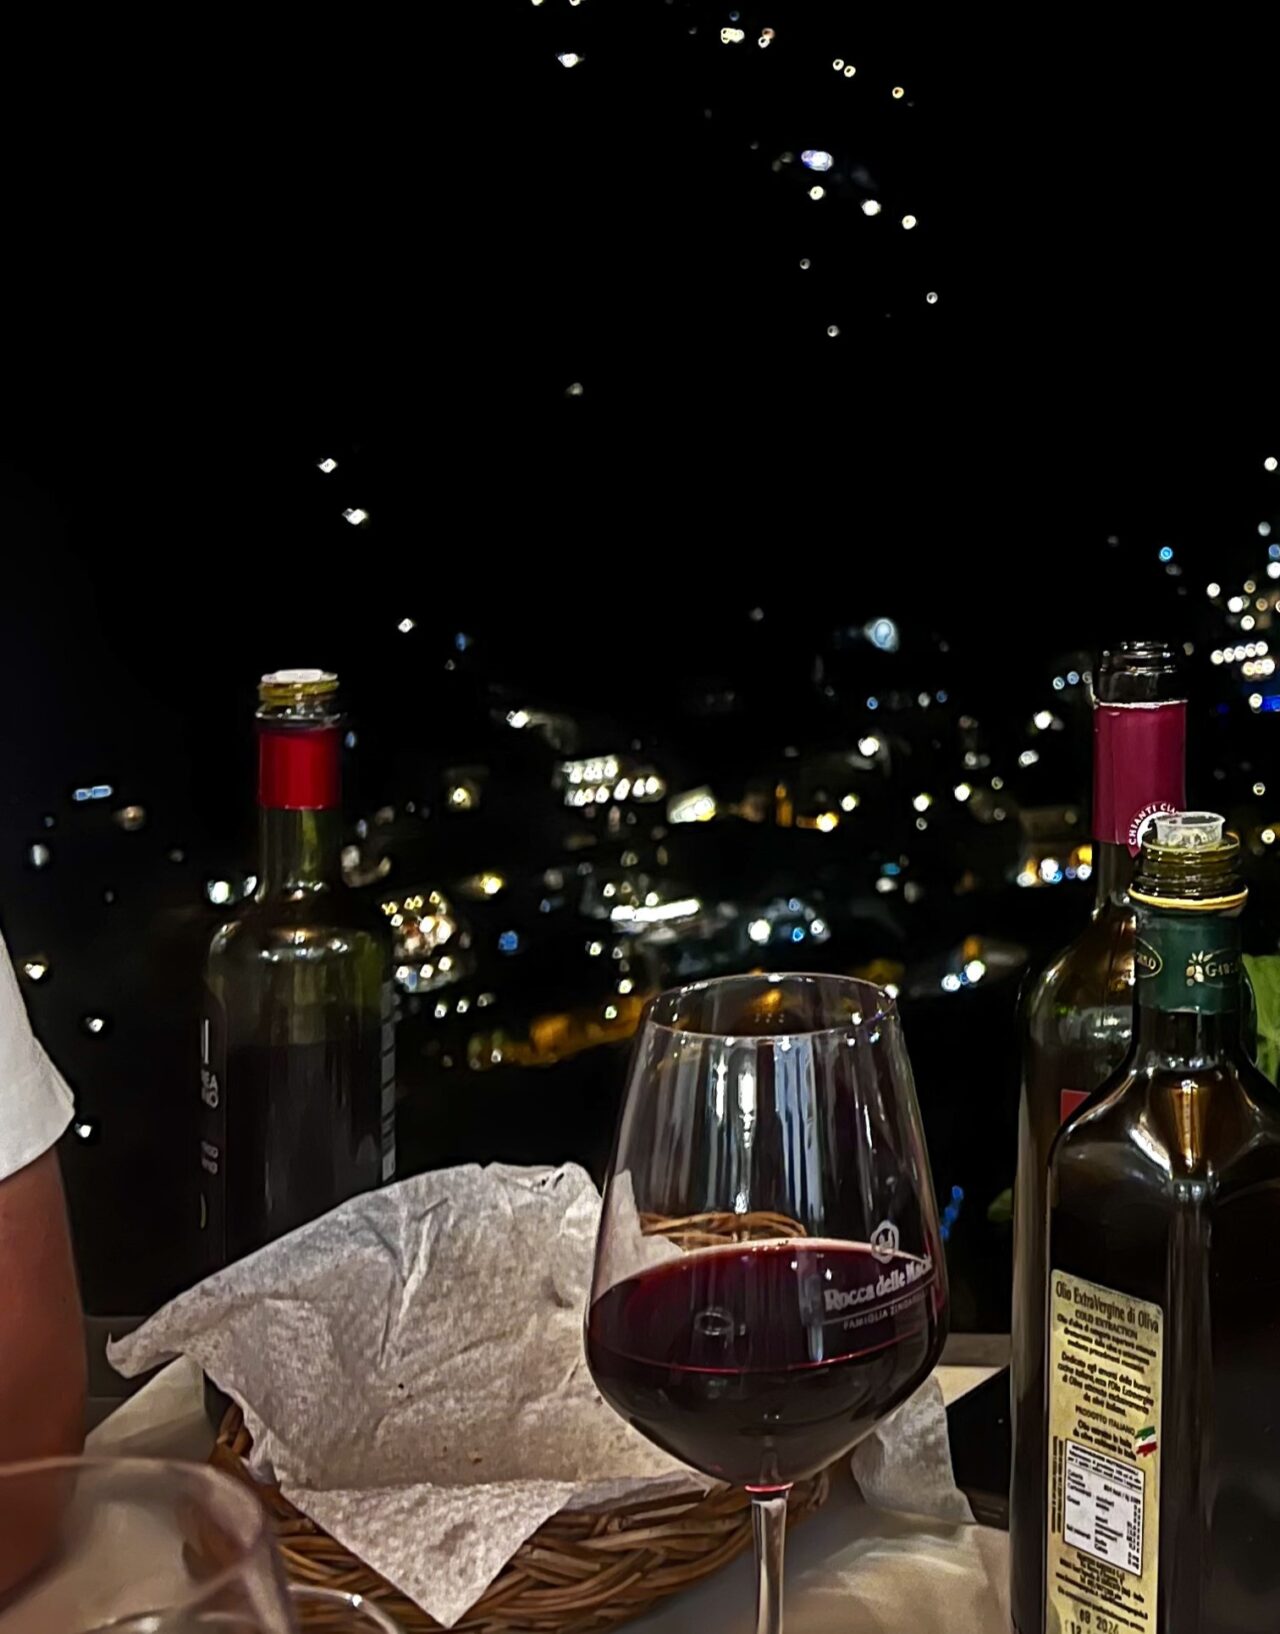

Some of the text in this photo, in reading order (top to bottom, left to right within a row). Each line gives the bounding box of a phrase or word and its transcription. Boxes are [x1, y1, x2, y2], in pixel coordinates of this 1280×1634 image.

[1128, 803, 1179, 846] CHIANTI CLA
[823, 1284, 874, 1312] Rocca
[876, 1270, 905, 1297] delle
[1055, 1281, 1159, 1334] Olio ExtraVergine di Oliva
[843, 1309, 888, 1330] FAMIGLIA
[1075, 1309, 1138, 1340] COLD EXTRACTION
[1075, 1405, 1135, 1436] PRODOTTO ITALIANO
